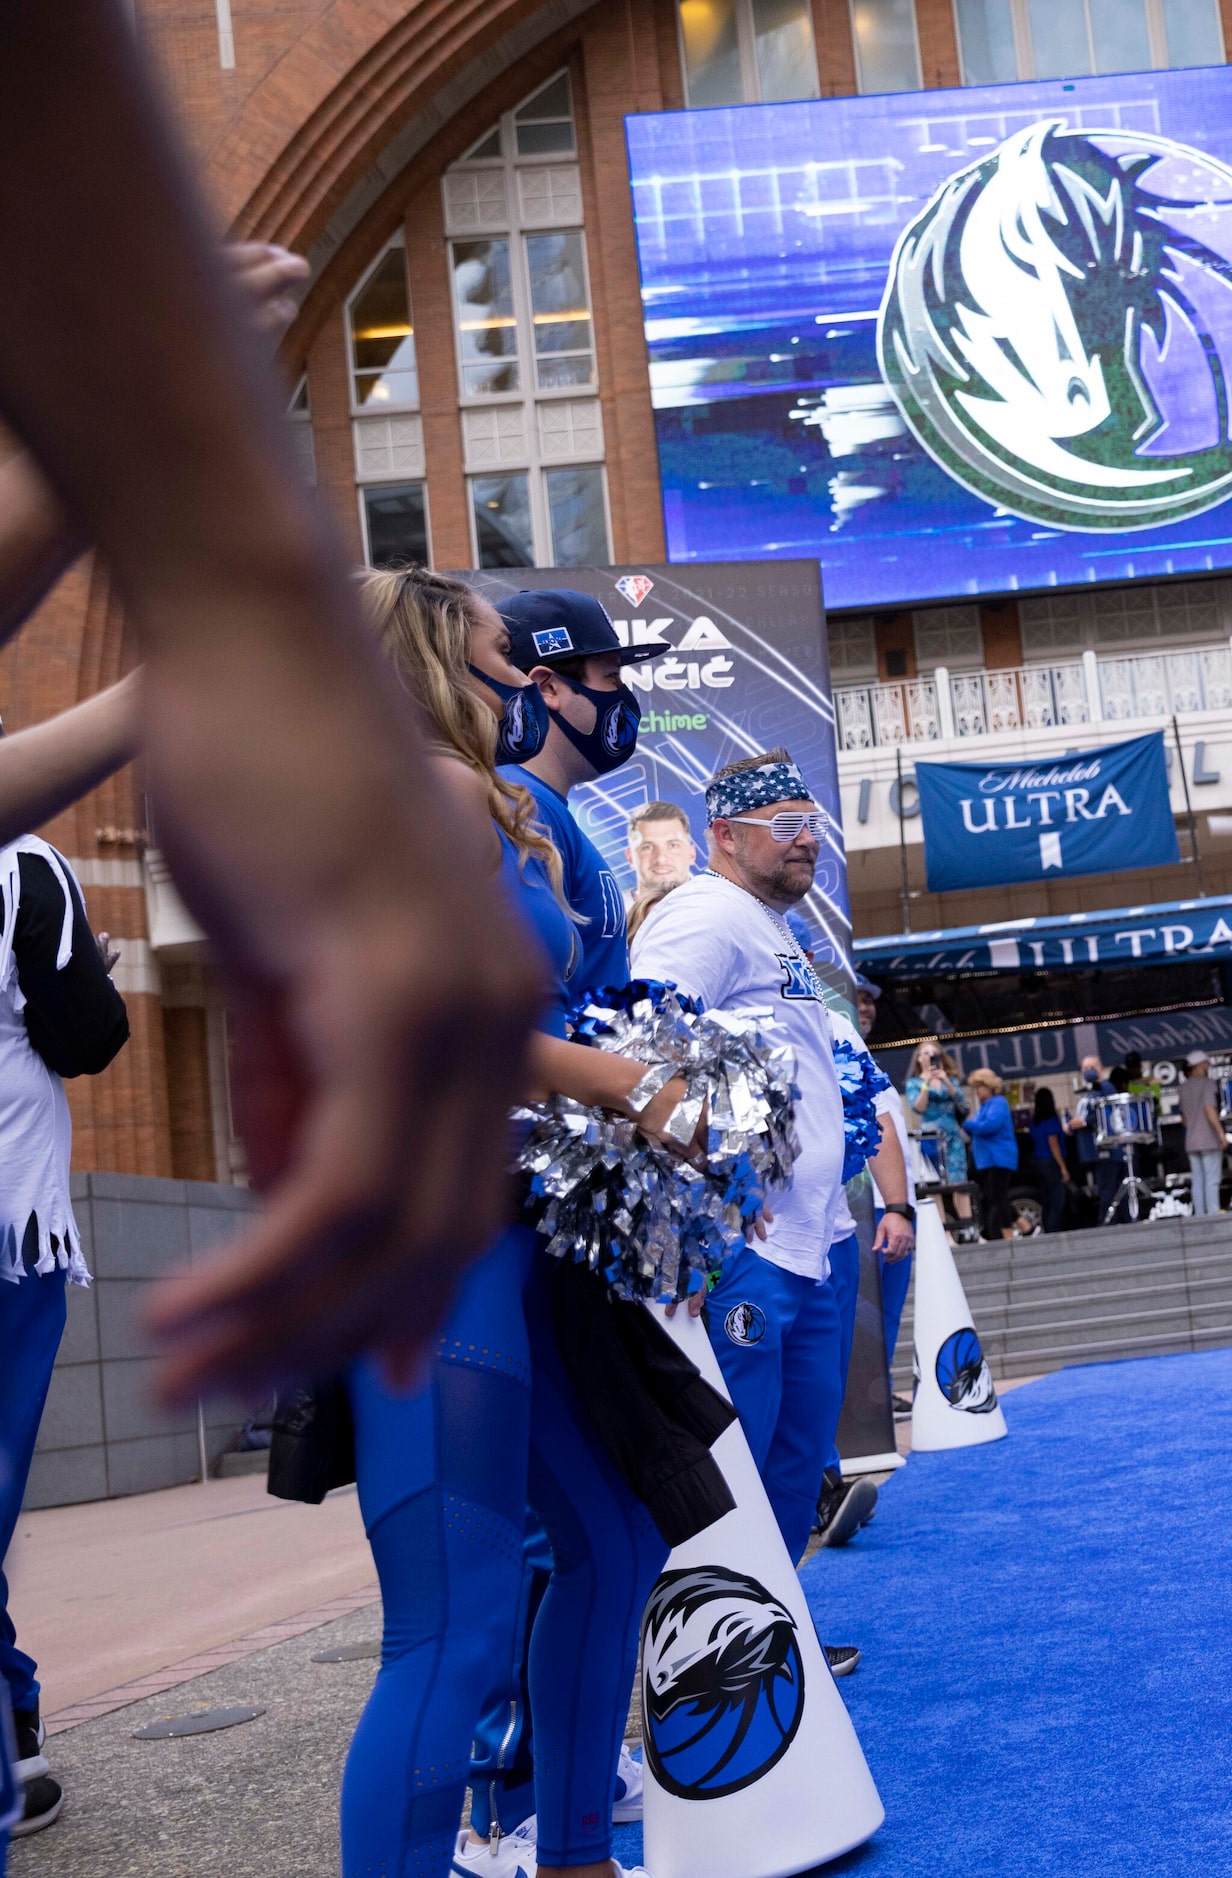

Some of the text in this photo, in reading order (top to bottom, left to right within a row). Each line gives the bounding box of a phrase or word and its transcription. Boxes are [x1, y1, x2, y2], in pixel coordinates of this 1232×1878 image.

[614, 616, 733, 651] KA
[620, 655, 735, 692] NČIĆ
[638, 709, 707, 733] chime
[978, 758, 1103, 794] Michelob
[959, 782, 1133, 834] ULTRA
